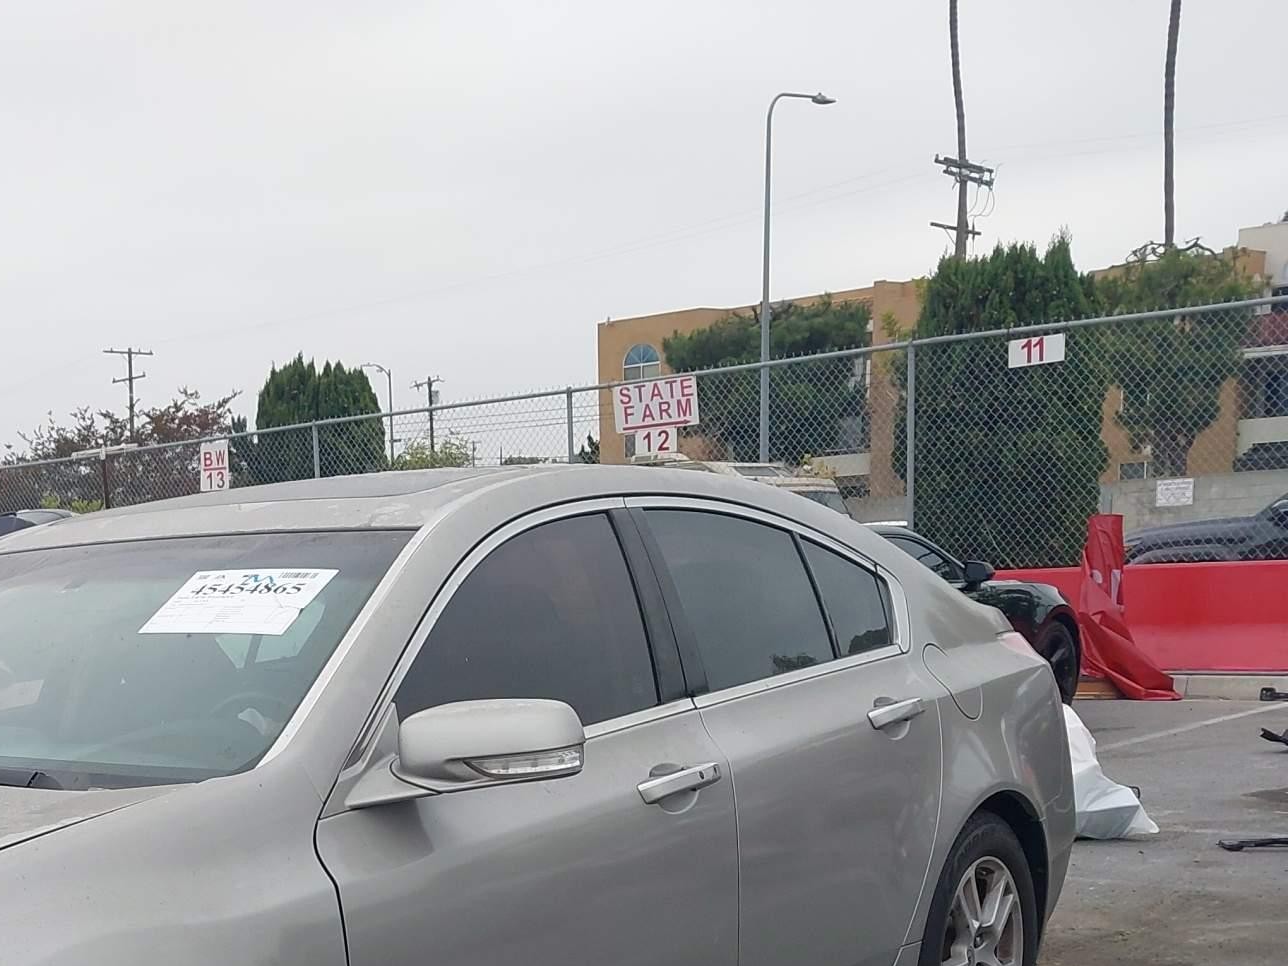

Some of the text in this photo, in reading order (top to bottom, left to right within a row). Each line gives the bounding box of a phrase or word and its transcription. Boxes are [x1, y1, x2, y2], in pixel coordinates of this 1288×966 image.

[1021, 336, 1044, 363] 11
[619, 378, 694, 405] STATE
[623, 398, 692, 424] FARM
[642, 430, 670, 452] 12
[203, 450, 225, 467] BW
[206, 471, 225, 489] 13
[191, 582, 307, 595] 45454865
